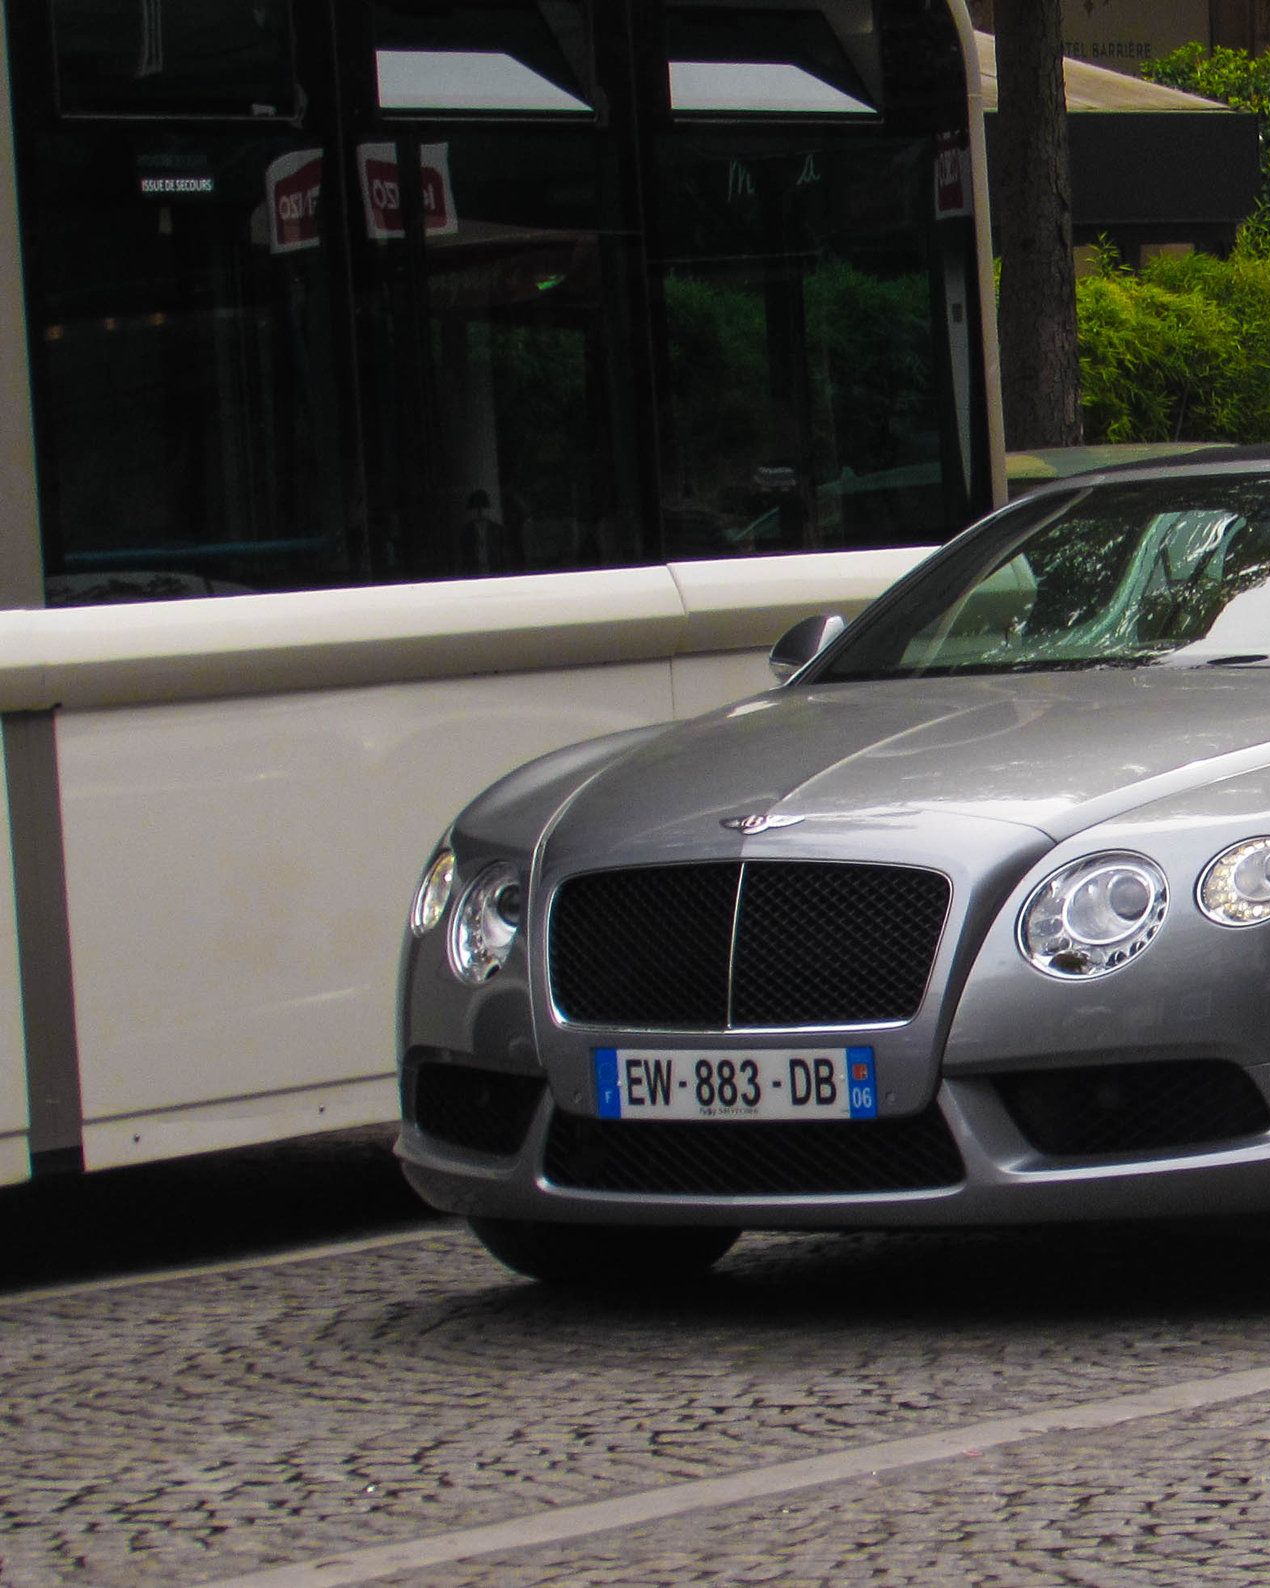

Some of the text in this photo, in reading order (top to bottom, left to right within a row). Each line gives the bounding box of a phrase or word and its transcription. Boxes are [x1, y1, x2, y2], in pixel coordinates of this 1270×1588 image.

[1063, 40, 1152, 58] TEL BARRIÈRE
[142, 179, 211, 191] ISSUE DE SECOURS
[604, 1091, 613, 1103] F
[852, 1087, 872, 1108] 06
